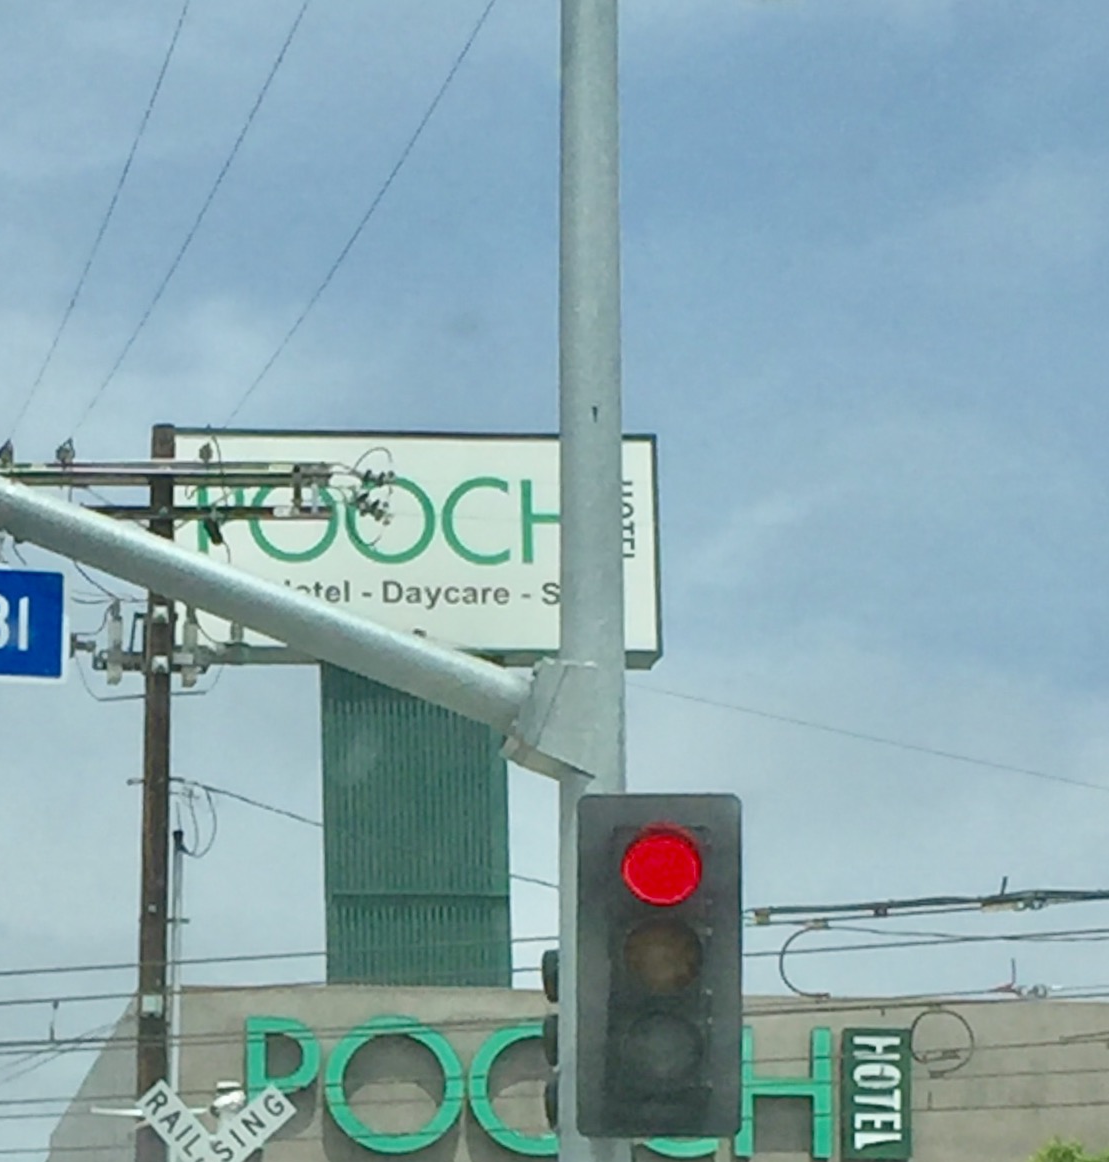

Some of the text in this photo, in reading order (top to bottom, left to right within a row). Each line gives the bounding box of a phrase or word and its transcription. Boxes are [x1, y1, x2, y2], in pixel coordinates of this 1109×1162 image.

[284, 580, 350, 603] tel
[382, 580, 510, 610] Daycare
[245, 1015, 832, 1159] POOH
[852, 1035, 902, 1150] HOTEL
